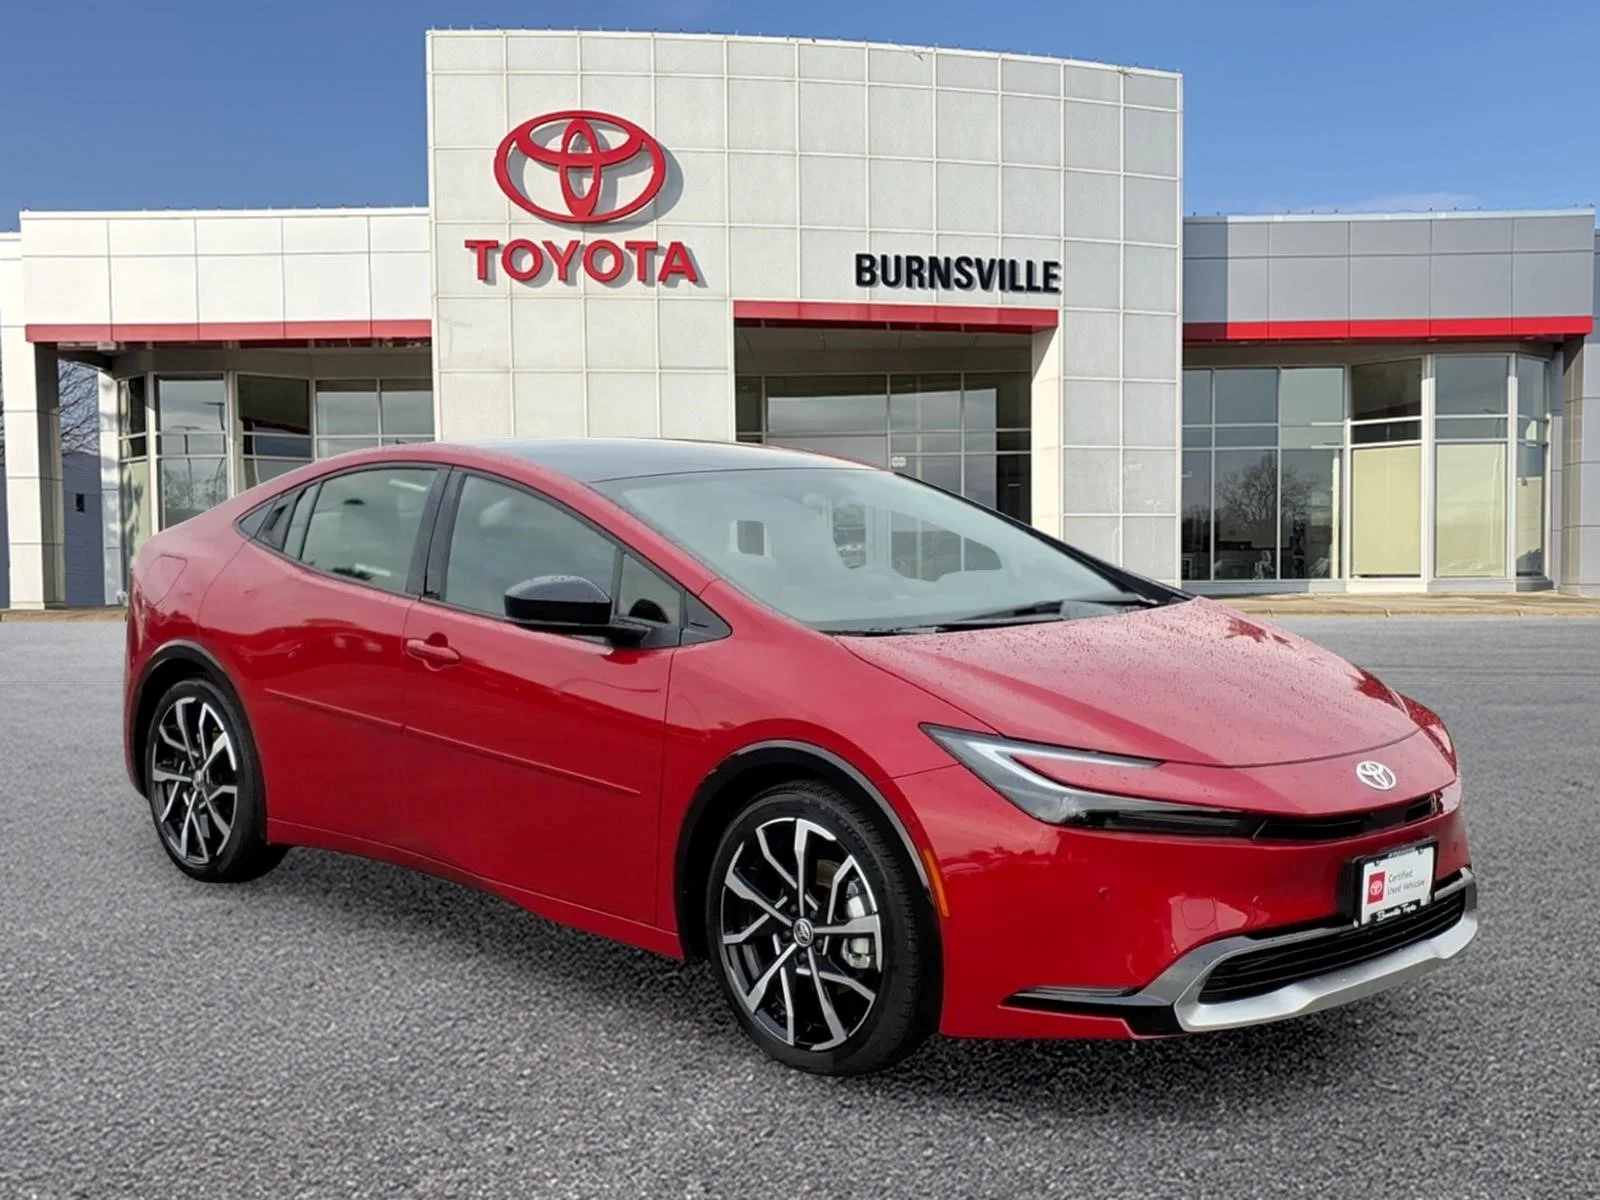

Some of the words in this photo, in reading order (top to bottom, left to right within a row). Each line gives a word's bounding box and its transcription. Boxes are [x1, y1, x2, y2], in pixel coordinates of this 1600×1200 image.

[464, 238, 698, 282] TOYOTA
[855, 253, 1061, 293] BURNSVILLE
[1387, 884, 1402, 896] Used
[1403, 879, 1425, 891] Vehicles
[1388, 870, 1413, 883] Certified
